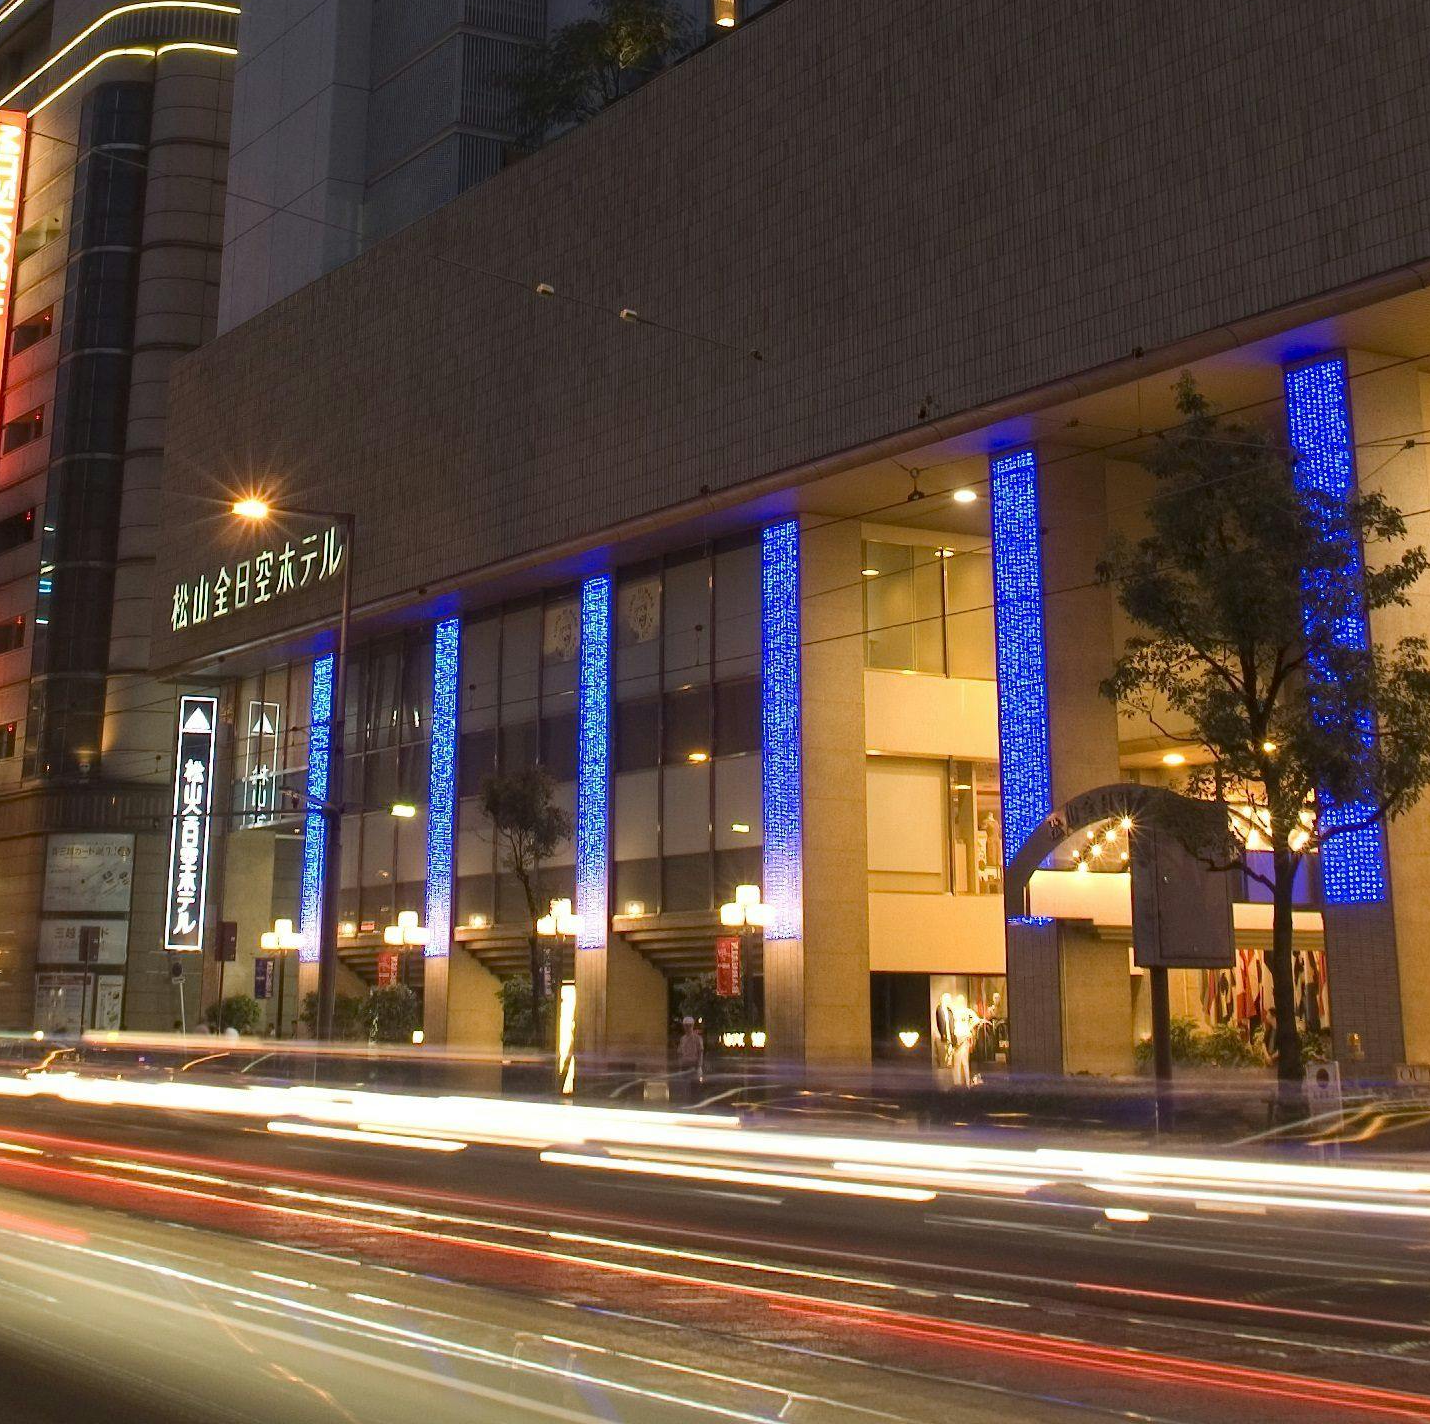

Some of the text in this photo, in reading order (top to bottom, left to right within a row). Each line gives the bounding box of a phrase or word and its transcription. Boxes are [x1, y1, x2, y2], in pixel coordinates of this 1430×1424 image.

[171, 526, 343, 632] 松山全日空ホテル
